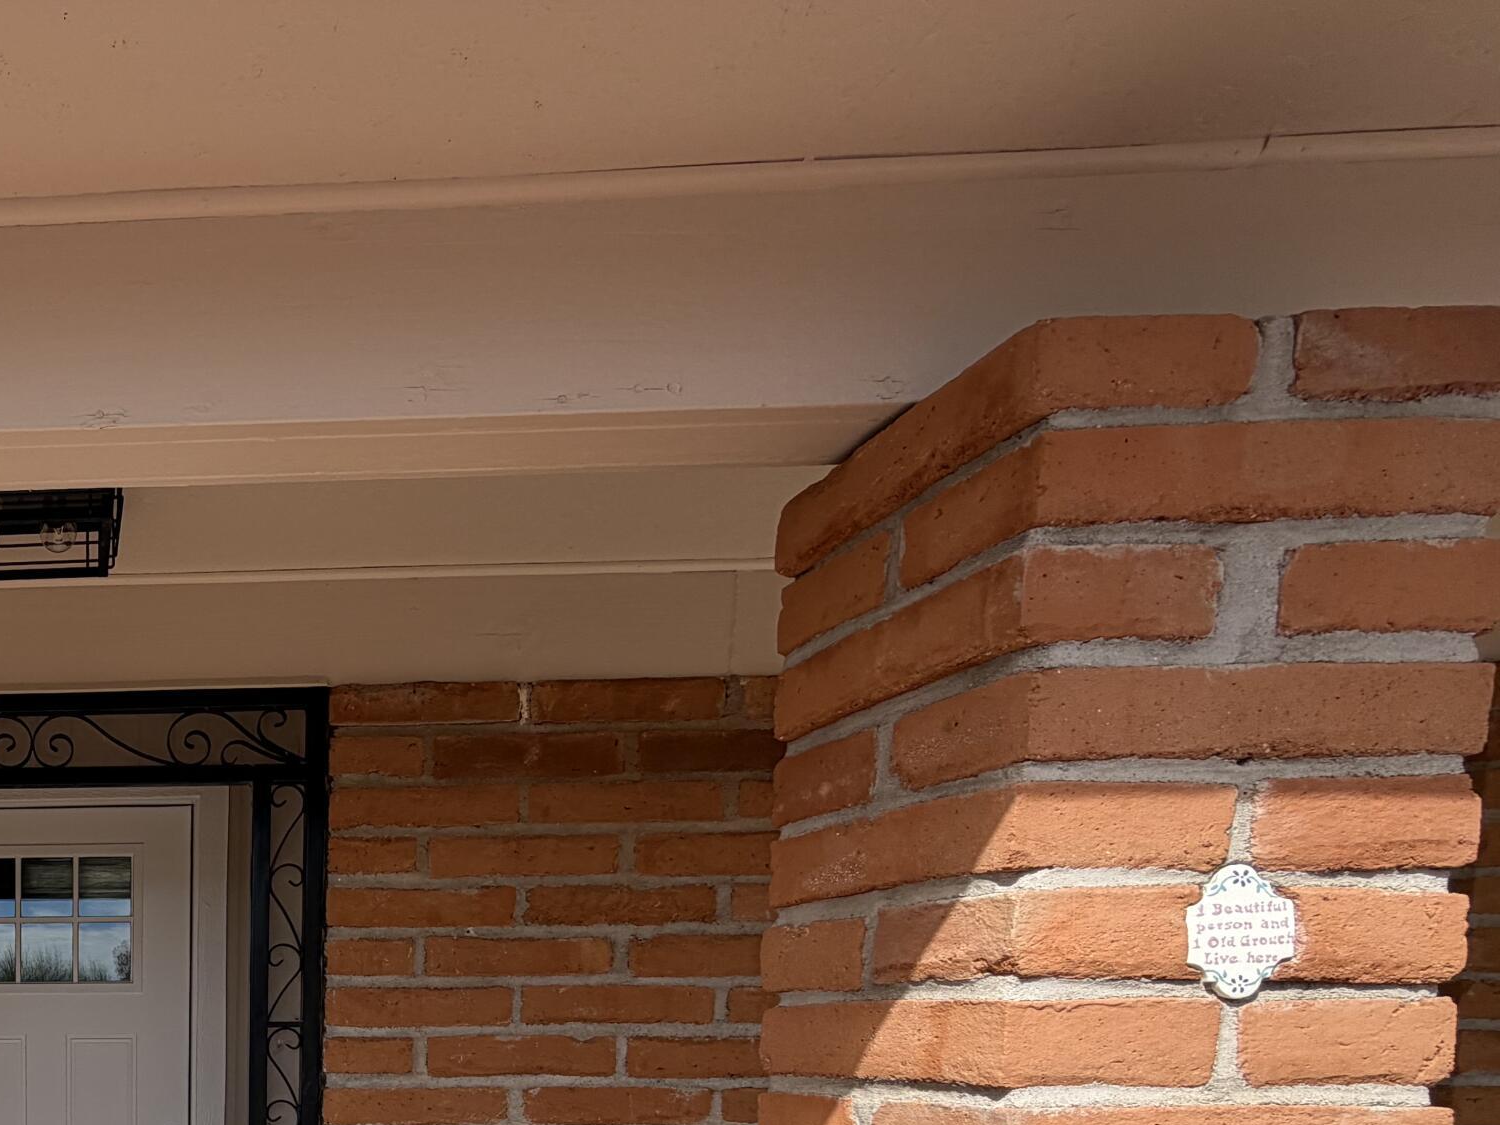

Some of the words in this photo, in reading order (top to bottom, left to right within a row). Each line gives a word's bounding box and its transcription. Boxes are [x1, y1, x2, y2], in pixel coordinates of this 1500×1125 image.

[1212, 901, 1287, 915] Beautiful
[1196, 920, 1253, 934] person
[1261, 917, 1289, 929] and
[1208, 936, 1236, 948] Old
[1240, 932, 1295, 947] Grouch
[1204, 952, 1238, 965] Live
[1247, 952, 1278, 963] here
